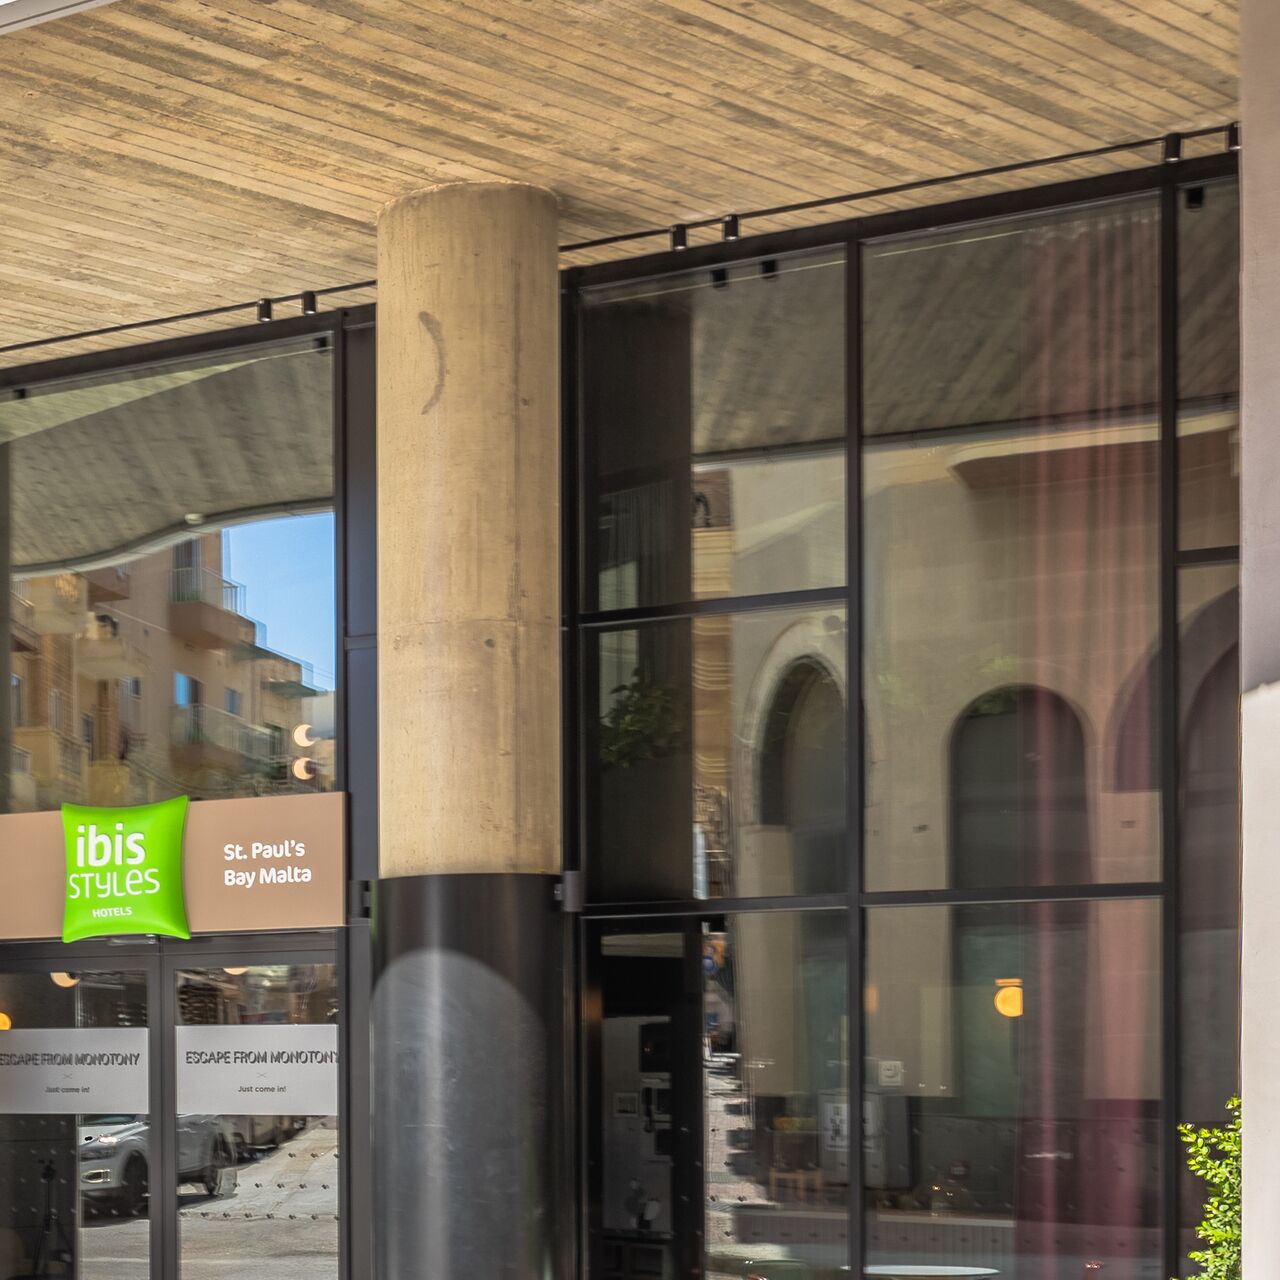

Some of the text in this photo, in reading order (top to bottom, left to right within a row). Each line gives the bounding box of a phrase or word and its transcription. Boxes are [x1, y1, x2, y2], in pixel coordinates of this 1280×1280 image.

[76, 822, 146, 867] ibis
[223, 839, 306, 861] St. Paul's
[224, 865, 312, 889] Bay Malta
[92, 906, 133, 918] HOTELS
[41, 1053, 71, 1066] FROM
[74, 1052, 141, 1066] MONOTONY
[185, 1051, 231, 1064] ESCAPE
[233, 1051, 267, 1064] FROM
[237, 1085, 253, 1093] Just
[277, 1085, 287, 1093] in!
